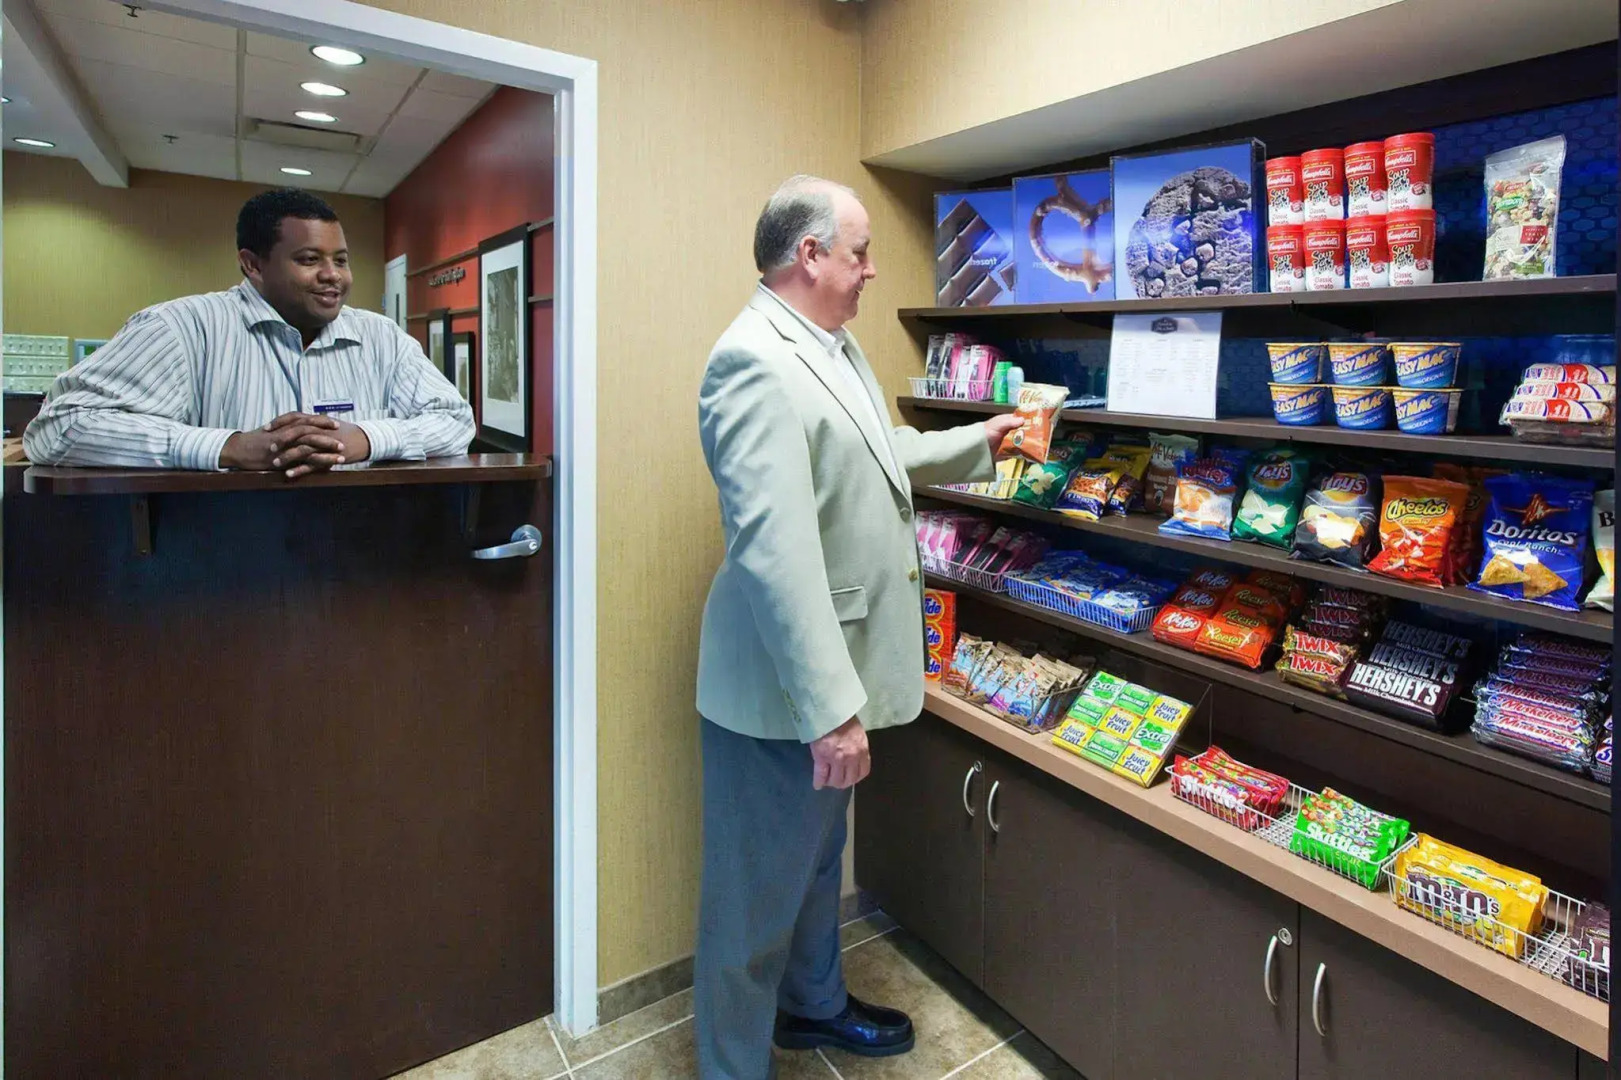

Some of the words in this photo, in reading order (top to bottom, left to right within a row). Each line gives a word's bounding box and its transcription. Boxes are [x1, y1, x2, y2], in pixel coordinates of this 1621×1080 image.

[1271, 358, 1286, 373] ASY
[1285, 349, 1309, 368] MAC
[1332, 359, 1356, 374] EASY
[1354, 350, 1381, 369] MAC
[1416, 350, 1448, 371] MAC
[1276, 400, 1297, 413] EASY
[1295, 391, 1320, 409] MAC
[1357, 393, 1384, 413] MAC
[1407, 395, 1436, 415] MAC
[1386, 498, 1447, 520] Cheetos
[1486, 519, 1578, 545] Doritos
[1523, 542, 1557, 554] Ranch
[1368, 642, 1458, 684] HERSHEY'S
[1349, 662, 1442, 706] HERSHEY'S
[1154, 708, 1176, 722] Fruit
[1157, 702, 1180, 715] Juicy
[1501, 698, 1580, 725] Musketeers
[1106, 720, 1127, 734] Fruit
[1109, 713, 1132, 726] Juicy
[1061, 731, 1081, 745] Fruit
[1064, 725, 1086, 738] Juicy
[1123, 760, 1146, 775] Fruit
[1126, 753, 1150, 767] Juicy
[1307, 822, 1378, 862] Skittles
